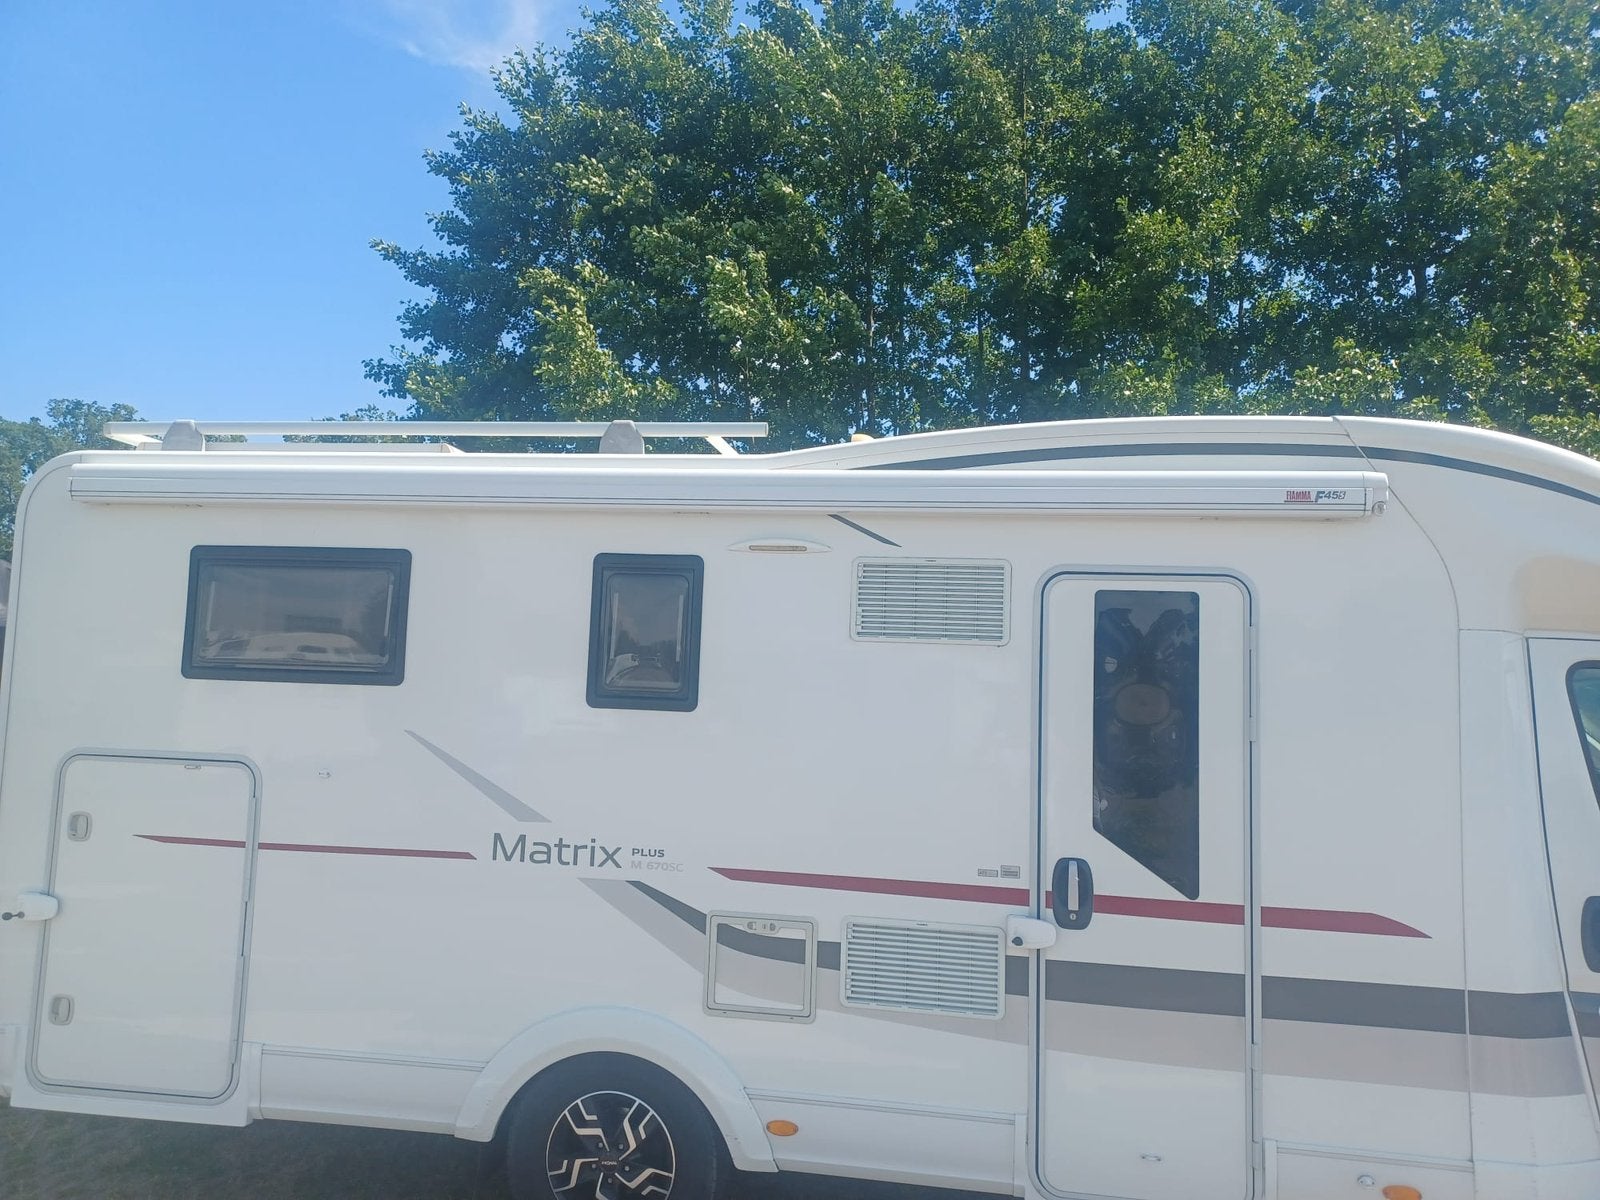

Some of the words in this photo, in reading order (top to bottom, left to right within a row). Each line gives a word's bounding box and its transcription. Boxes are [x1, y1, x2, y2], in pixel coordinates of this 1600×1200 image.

[1286, 490, 1312, 501] FIAMMA
[491, 832, 623, 869] Matrix
[631, 847, 665, 858] PLUS
[630, 860, 642, 870] M
[646, 861, 685, 873] 670SC
